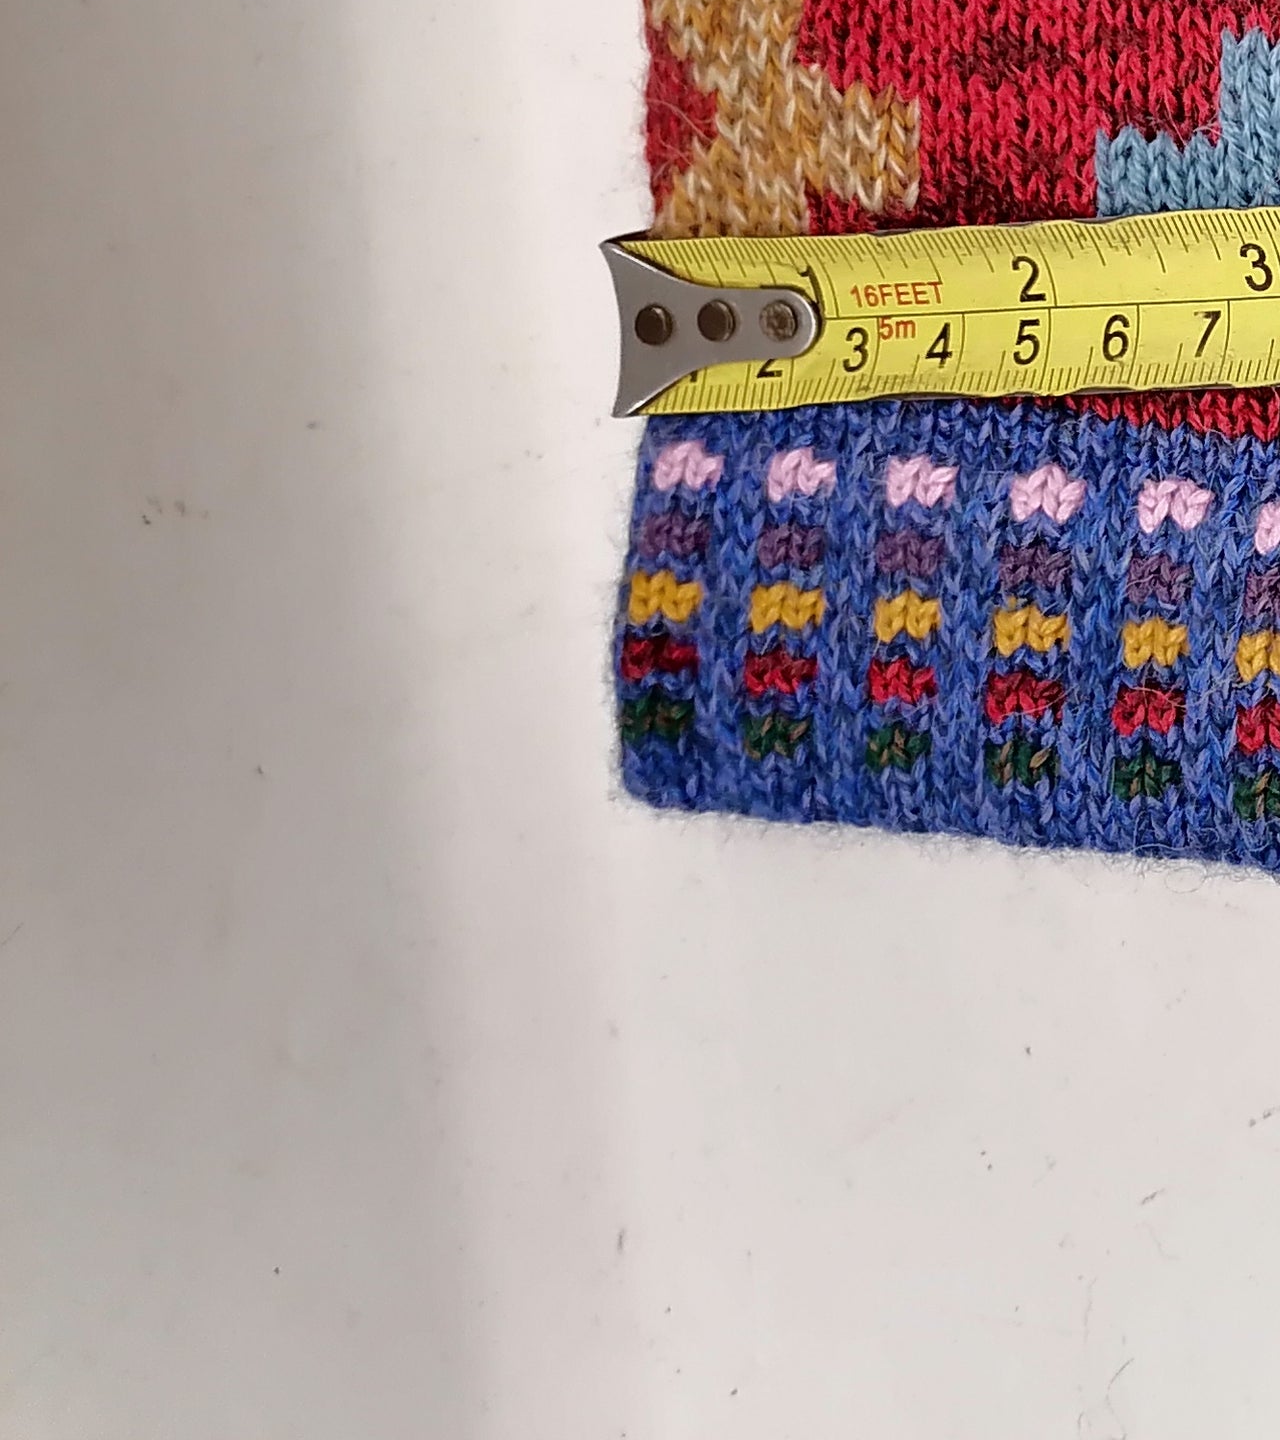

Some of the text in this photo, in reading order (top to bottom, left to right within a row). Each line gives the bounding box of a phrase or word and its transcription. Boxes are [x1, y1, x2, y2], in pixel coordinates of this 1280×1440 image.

[1012, 255, 1046, 303] 2
[1238, 242, 1274, 292] 3
[849, 281, 943, 309] 16FEET
[842, 326, 870, 372] 3
[925, 322, 953, 365] 4
[1012, 318, 1042, 365] 5
[1101, 314, 1130, 362] 6
[1193, 310, 1222, 358] 7
[877, 315, 917, 341] 5m
